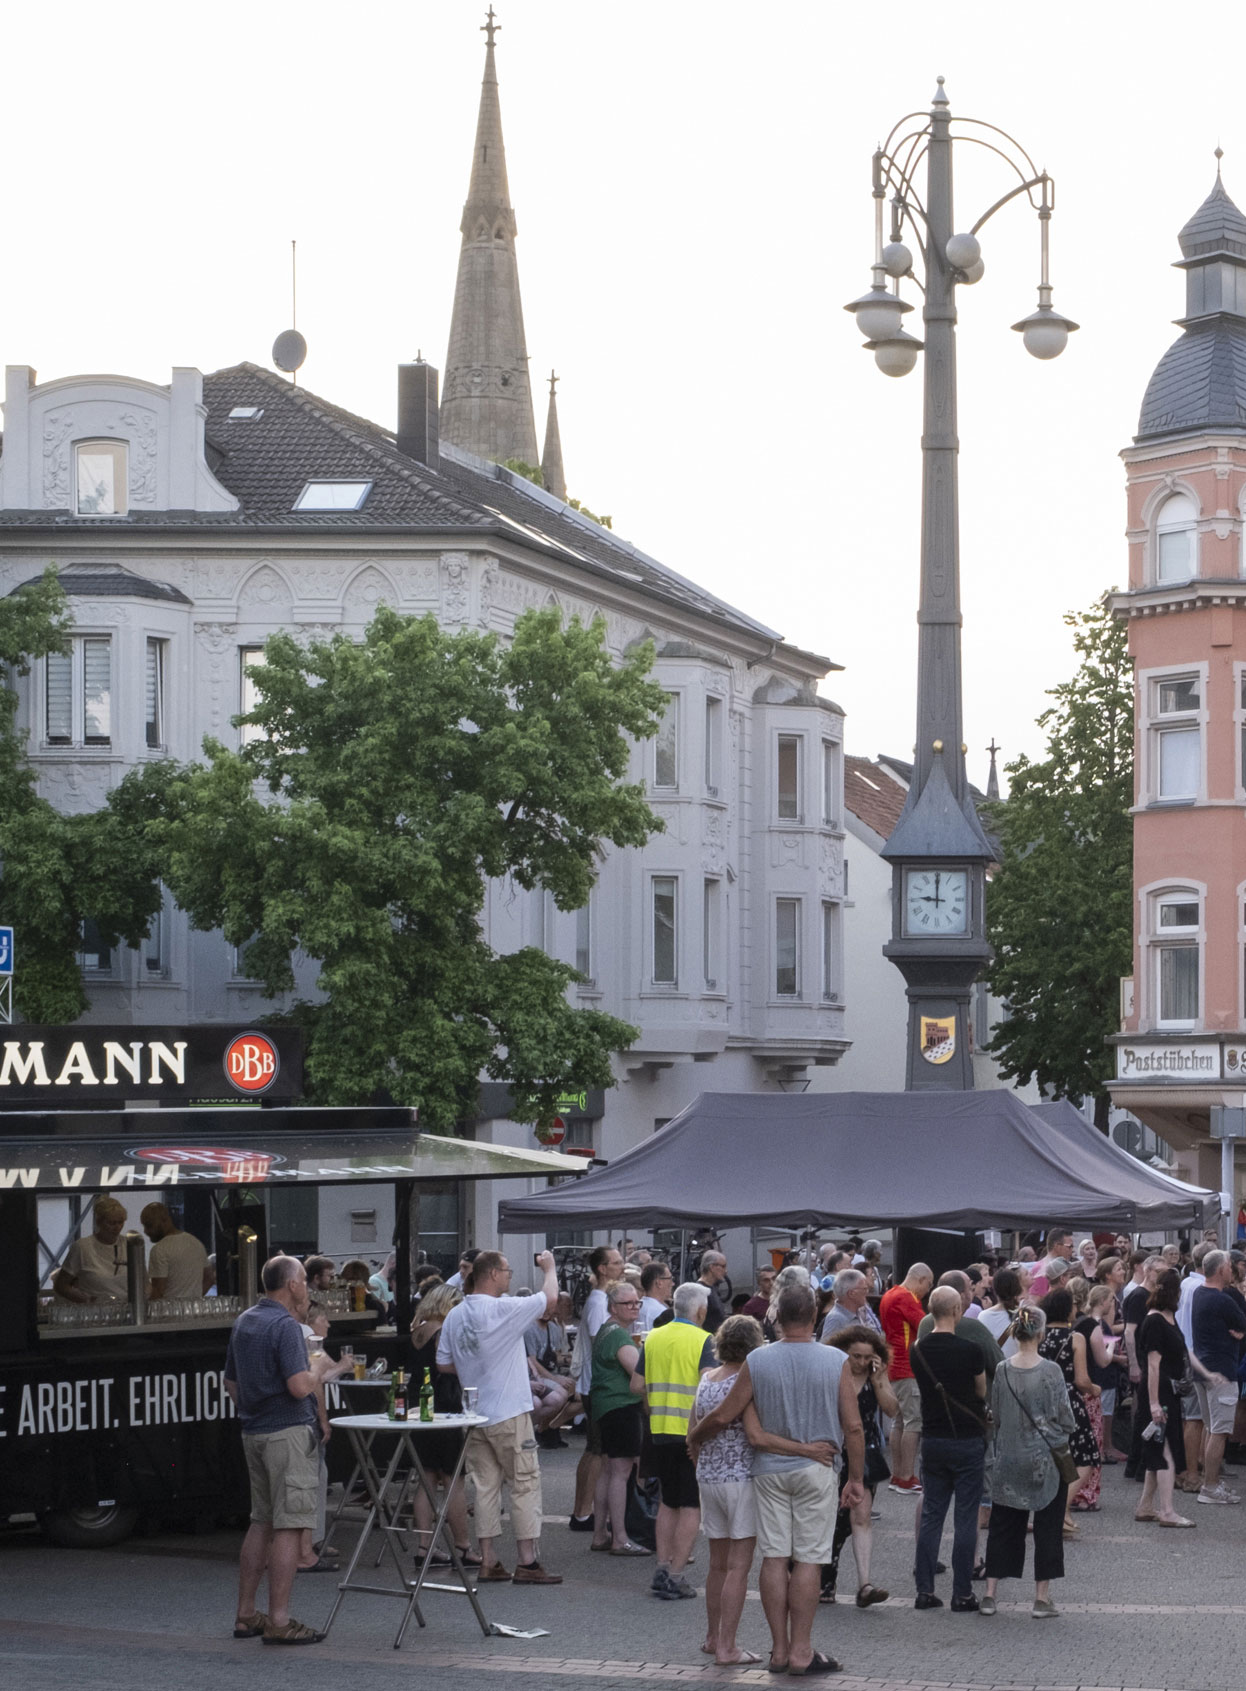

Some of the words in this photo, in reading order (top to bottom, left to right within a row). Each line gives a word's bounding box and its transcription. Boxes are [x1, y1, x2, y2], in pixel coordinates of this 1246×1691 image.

[0, 1042, 188, 1085] MANN
[231, 1044, 275, 1081] DBB
[1122, 1048, 1214, 1074] Poststübchen
[17, 1378, 120, 1436] ARBEIT.
